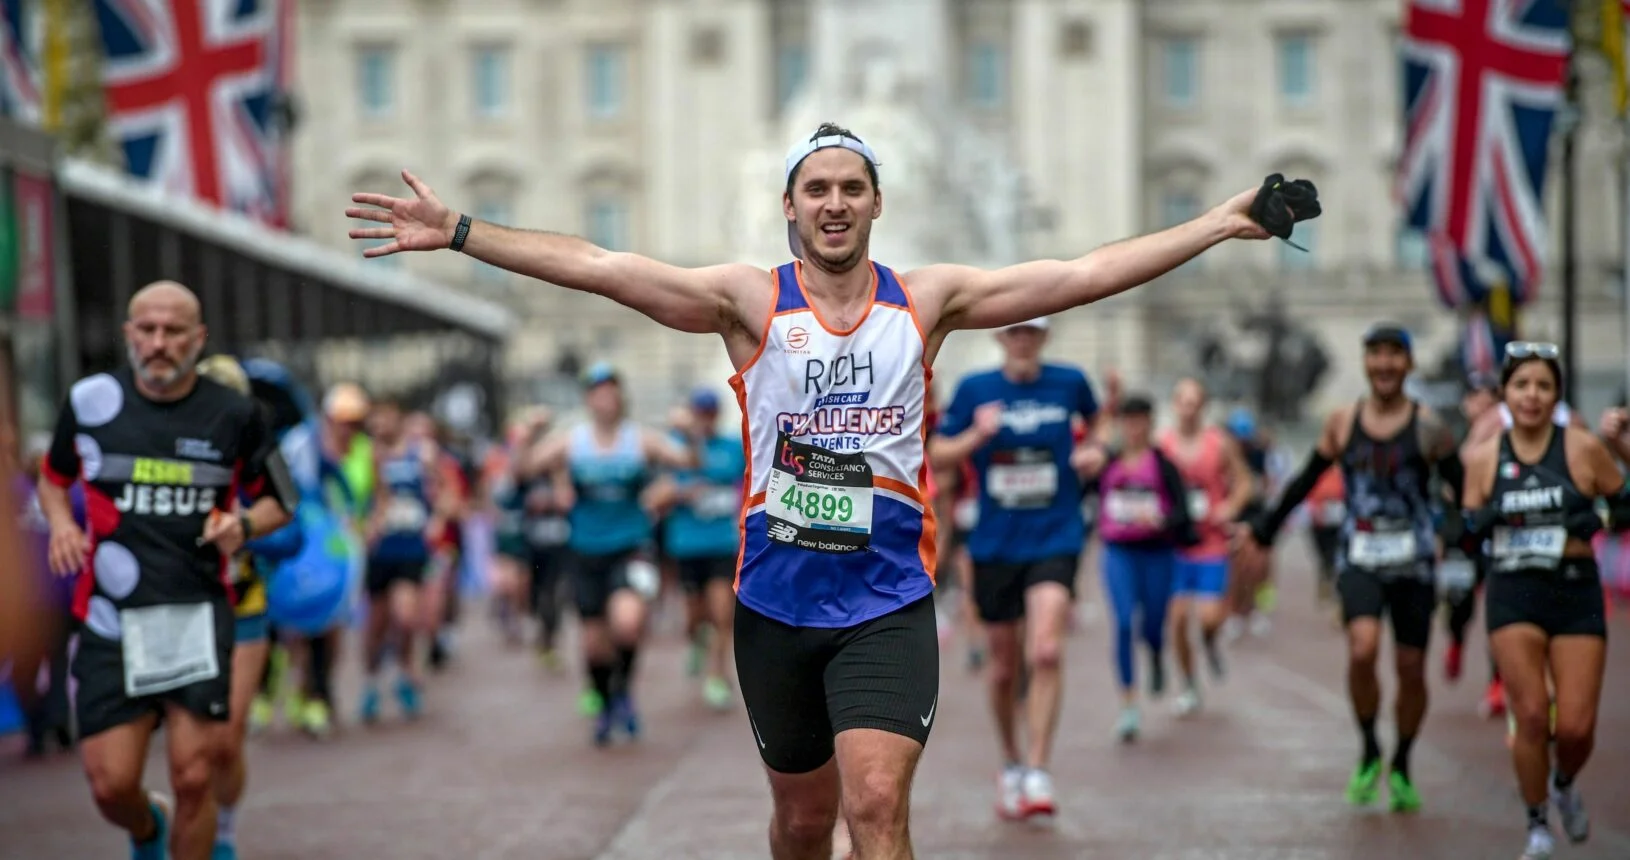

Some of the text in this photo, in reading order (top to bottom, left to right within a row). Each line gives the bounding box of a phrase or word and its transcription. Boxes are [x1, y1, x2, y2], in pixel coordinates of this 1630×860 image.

[804, 351, 874, 394] RICH
[841, 394, 863, 403] CARE
[776, 406, 905, 437] CHALLENGE
[811, 436, 861, 450] EVENTS
[811, 452, 836, 465] TATA
[808, 460, 866, 473] CONSULTANCY
[807, 469, 845, 481] SERVICES
[114, 483, 217, 516] JESUS
[797, 539, 860, 552] new balance
